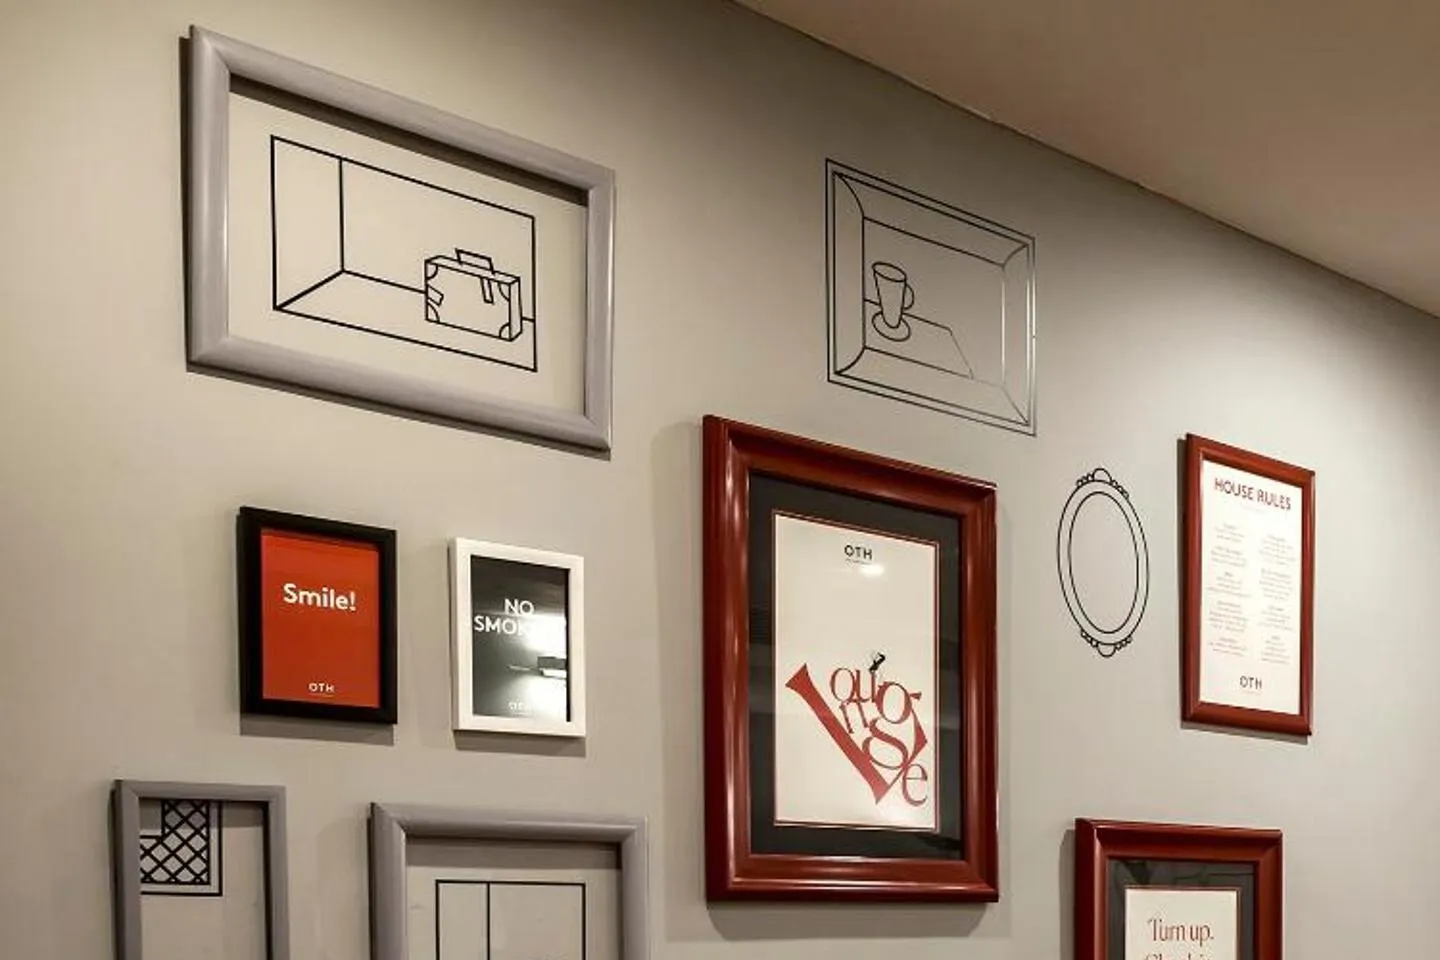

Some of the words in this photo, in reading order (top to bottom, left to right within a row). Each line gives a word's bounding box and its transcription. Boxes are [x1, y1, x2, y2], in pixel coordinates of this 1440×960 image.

[1214, 477, 1254, 501] HOUSE
[1257, 488, 1291, 511] RULES
[844, 544, 872, 560] OTH
[283, 582, 356, 611] Smile!
[504, 598, 535, 616] NO
[308, 682, 335, 693] OTH
[1239, 675, 1262, 690] OTH
[1147, 917, 1186, 943] Turn
[1189, 922, 1214, 947] up.
